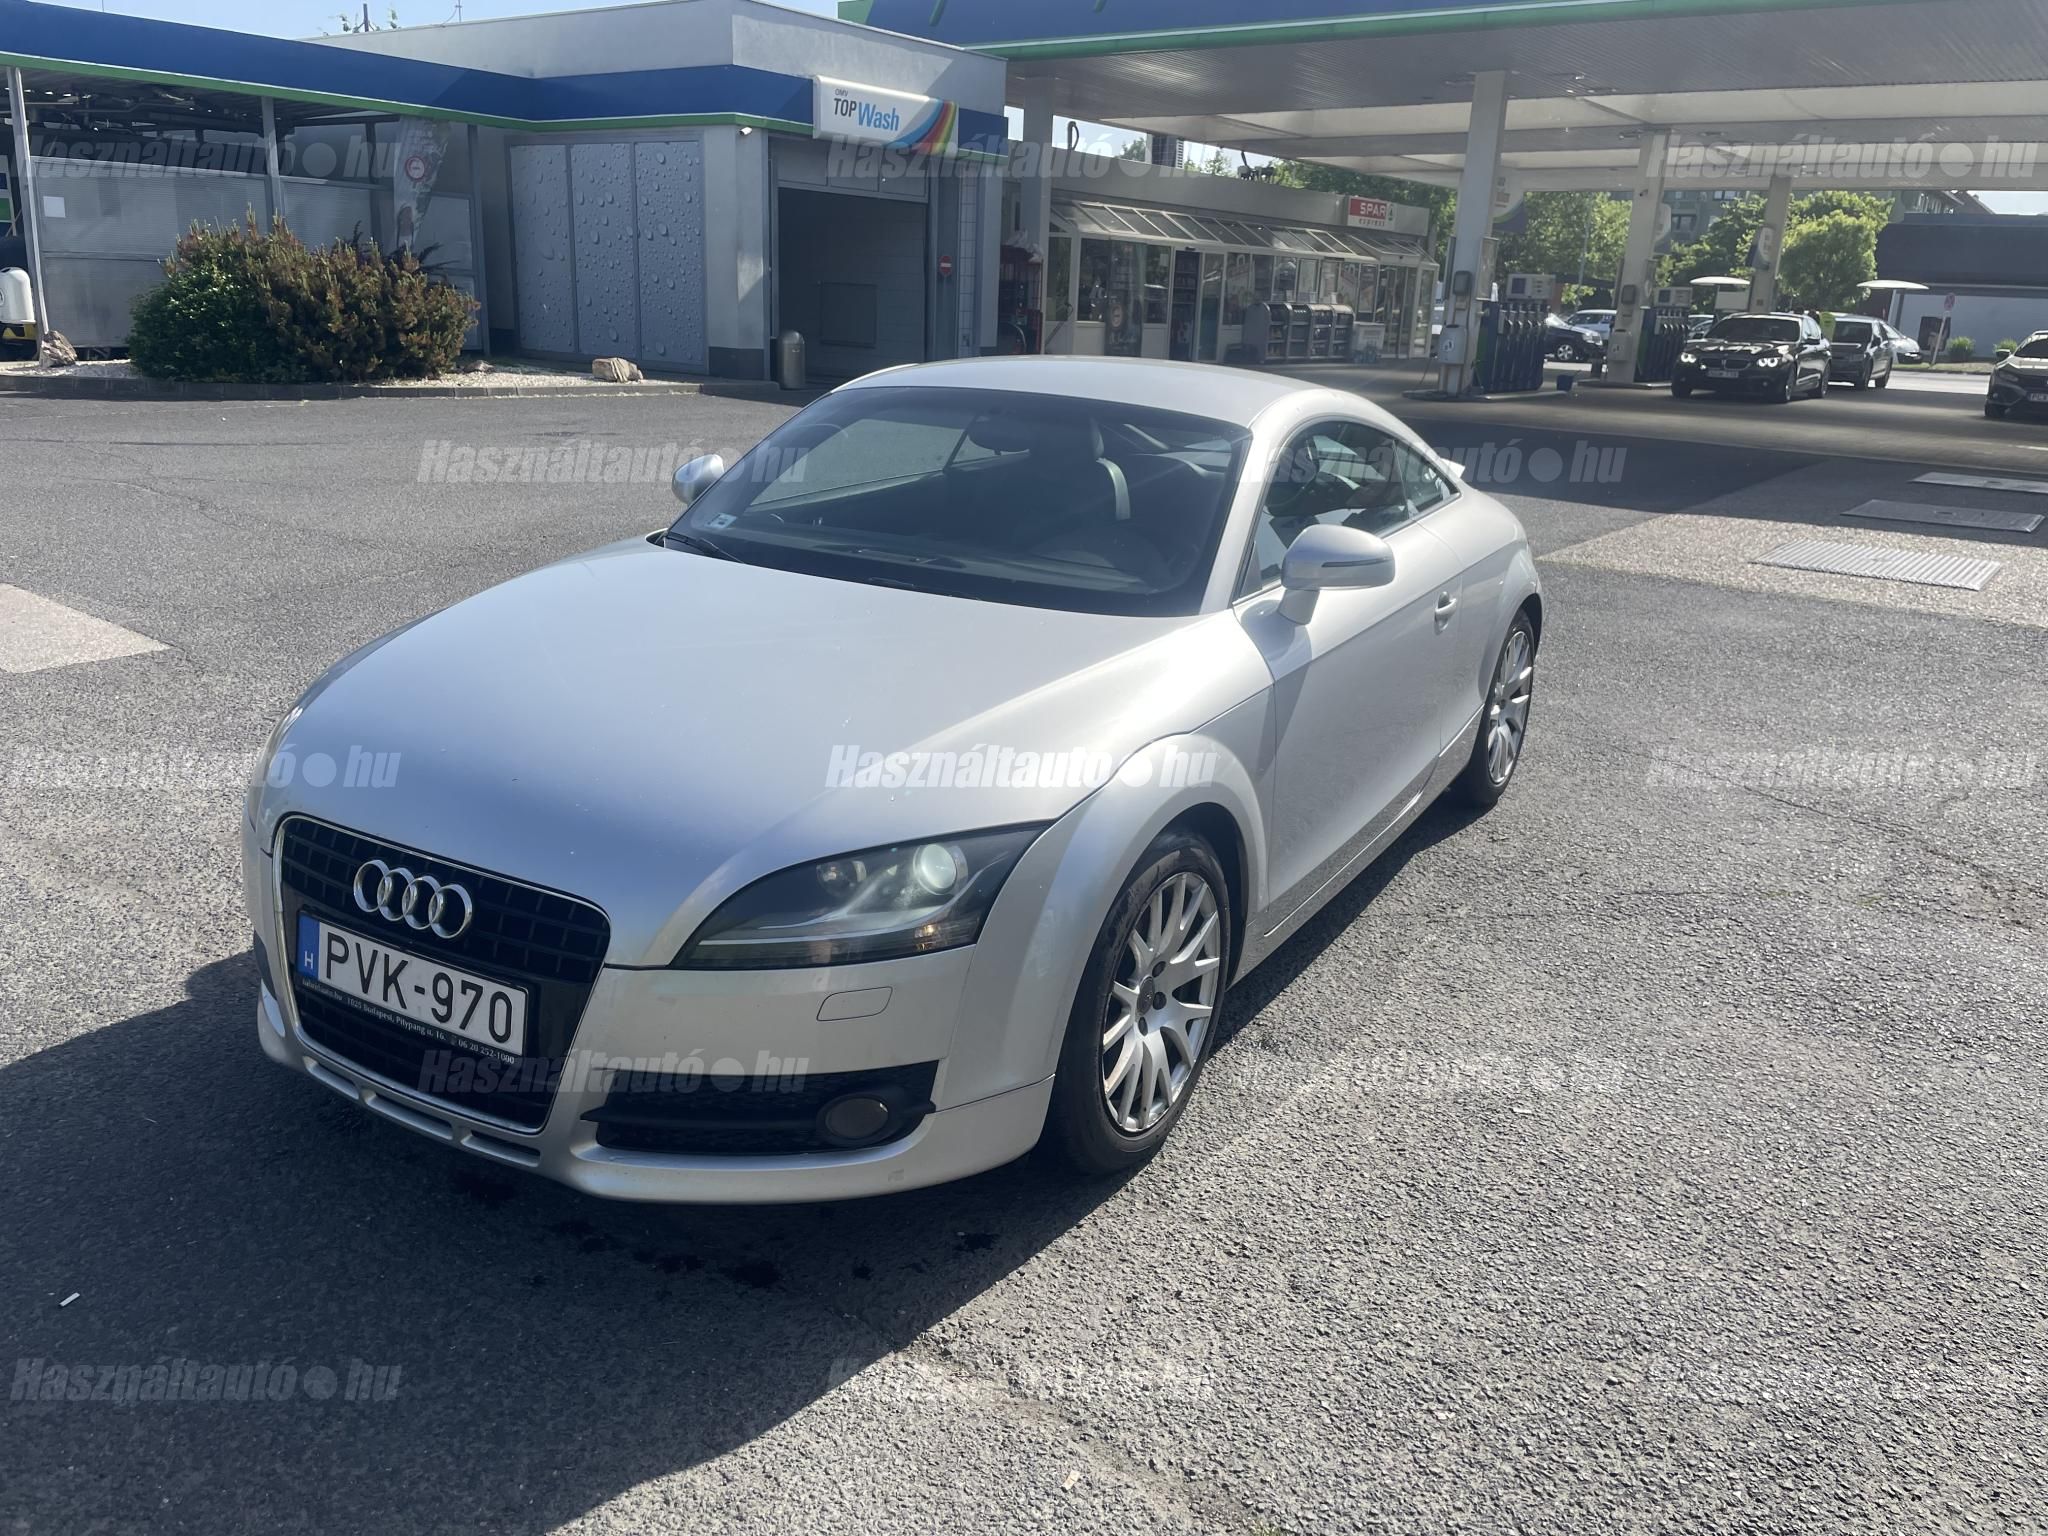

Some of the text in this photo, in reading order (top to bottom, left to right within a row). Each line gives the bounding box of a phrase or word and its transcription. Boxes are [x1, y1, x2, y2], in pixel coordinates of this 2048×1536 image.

[834, 88, 849, 97] OMV
[1360, 202, 1386, 217] SPAR
[303, 951, 314, 970] H
[326, 931, 513, 1044] PVK-970
